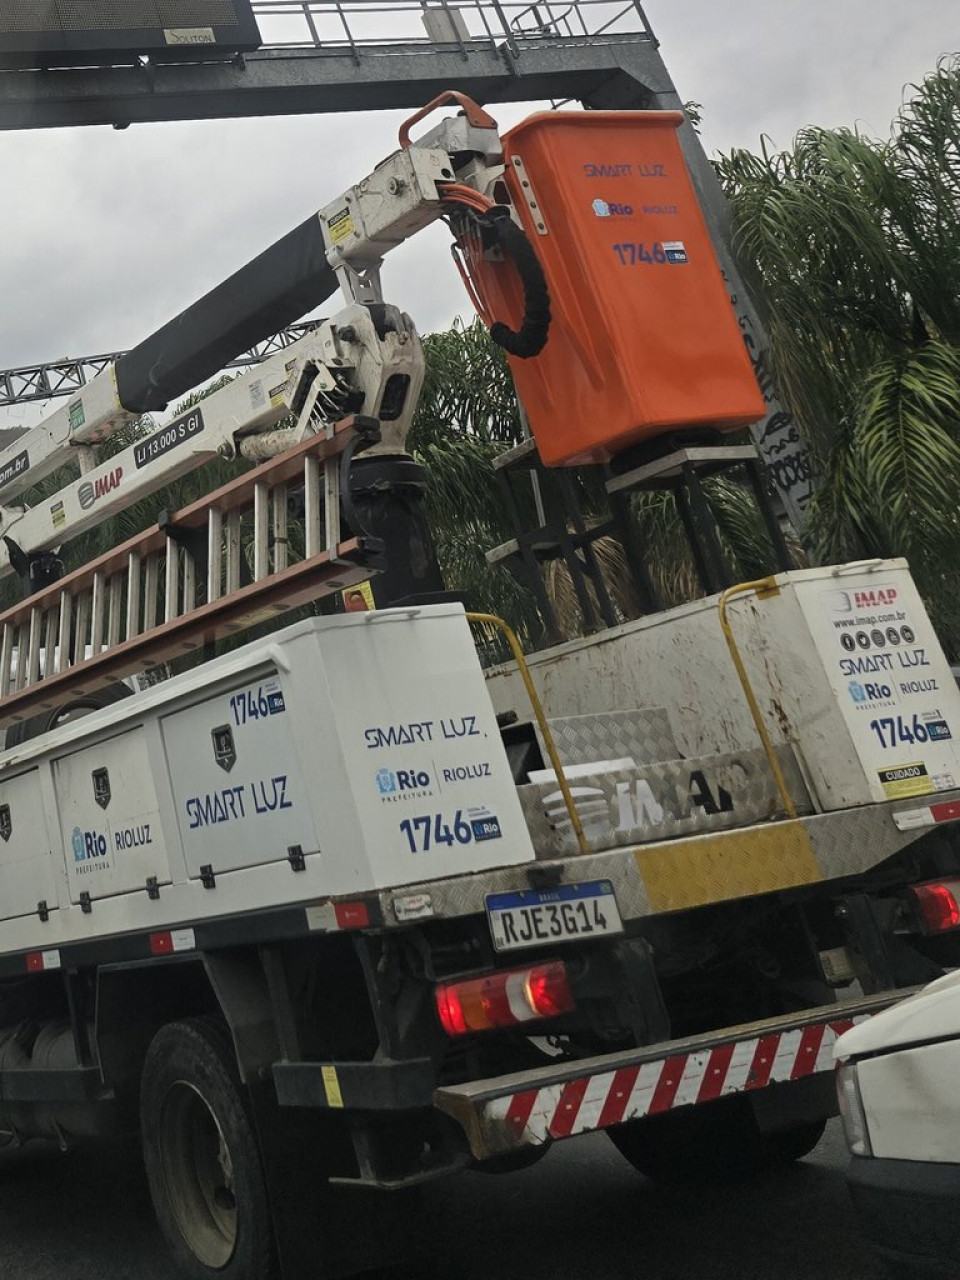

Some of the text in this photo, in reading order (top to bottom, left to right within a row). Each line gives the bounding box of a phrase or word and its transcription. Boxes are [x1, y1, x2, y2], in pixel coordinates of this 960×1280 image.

[583, 163, 667, 177] SMART LUZ
[609, 203, 633, 215] Rio
[613, 242, 666, 266] 1746
[148, 429, 177, 456] 13.000
[178, 423, 186, 437] S
[834, 610, 906, 628] www.imap.com.br
[839, 649, 930, 676] SMART LUZ
[865, 679, 939, 700] Rio RIOLUZ
[230, 687, 268, 725] 1746
[364, 716, 480, 749] SMART LUZ
[870, 714, 928, 748] 1746
[396, 763, 492, 790] Rio RIOLUZ
[885, 766, 921, 781] CUIDADO
[185, 775, 293, 828] SMART LUZ
[85, 824, 152, 859] Rio RIOLUZ
[400, 809, 472, 853] 1746
[500, 900, 608, 944] RJE3G14
